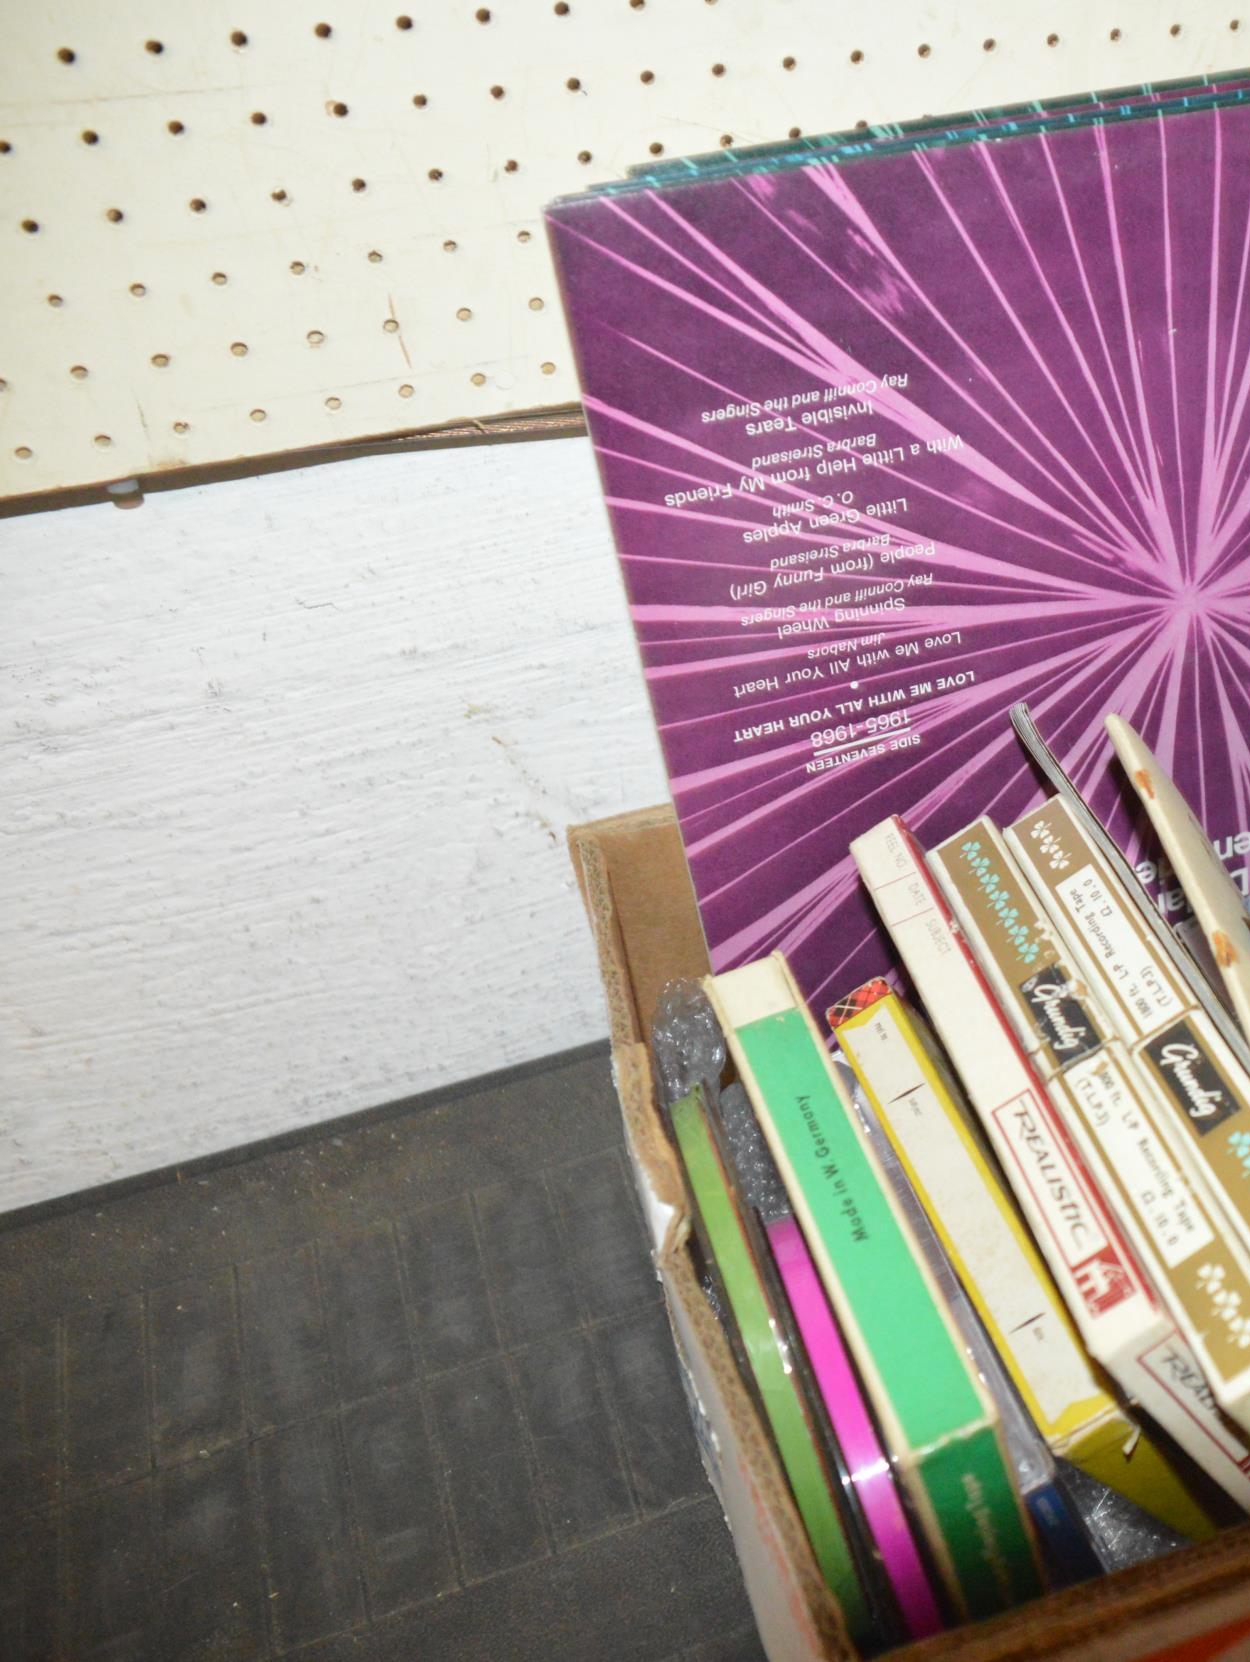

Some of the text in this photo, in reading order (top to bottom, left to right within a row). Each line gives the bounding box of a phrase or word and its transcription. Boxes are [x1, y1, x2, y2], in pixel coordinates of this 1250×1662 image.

[701, 373, 908, 423] Ray Conniff and the Singers
[745, 400, 873, 435] Invisible Tears
[664, 434, 963, 507] With a Little Help from My Friends
[752, 434, 876, 470] Barbra Streisand
[743, 497, 907, 543] Little Green Apples
[773, 498, 815, 517] Smith
[730, 543, 935, 600] People (from Funny Girl)
[770, 533, 890, 570] Barbra Streisand
[741, 573, 933, 627] Ray Conniff and the Singers
[777, 597, 905, 640] Spinning Wheel
[734, 631, 961, 698] Love Me with All Your Heart
[808, 632, 885, 659] Jim Nabors
[734, 670, 975, 743] LOVE ME WITH ALL YOUR HEART
[810, 708, 911, 748] 1965-1968
[806, 733, 921, 773] SIDE SEVENTEEN
[1065, 886, 1088, 912] Tape
[1081, 911, 1117, 958] Recording
[1034, 984, 1083, 1050] Grundig
[1159, 1043, 1222, 1118] Grundig
[796, 1094, 832, 1159] Germany
[1095, 1067, 1116, 1091] 800
[1133, 1137, 1177, 1199] Recording
[1169, 1199, 1197, 1234] Tape
[833, 1182, 849, 1198] in
[1013, 1108, 1090, 1245] REALISTIC
[839, 1206, 869, 1242] Made
